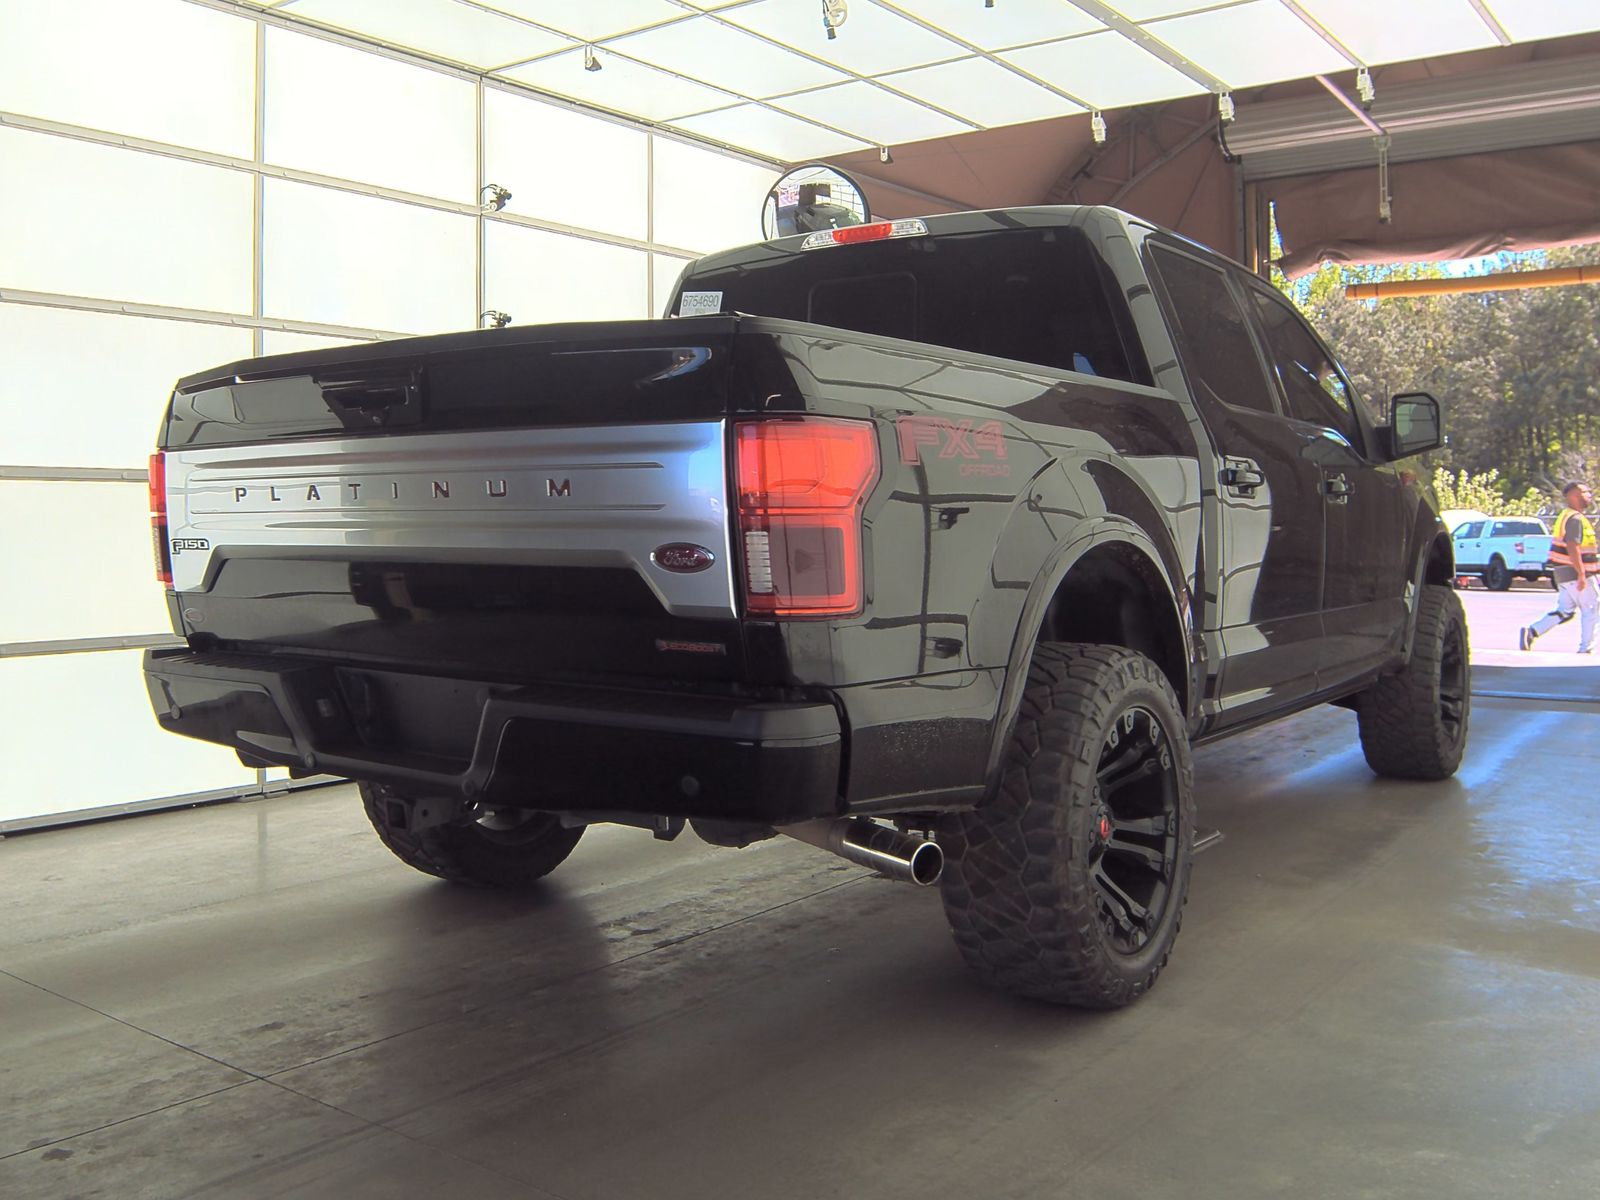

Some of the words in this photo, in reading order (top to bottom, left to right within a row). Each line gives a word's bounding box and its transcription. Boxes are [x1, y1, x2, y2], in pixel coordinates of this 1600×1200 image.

[682, 294, 719, 307] 6754690
[896, 415, 1008, 466] FX4
[235, 478, 571, 502] PLATINUM
[663, 549, 699, 567] Ford
